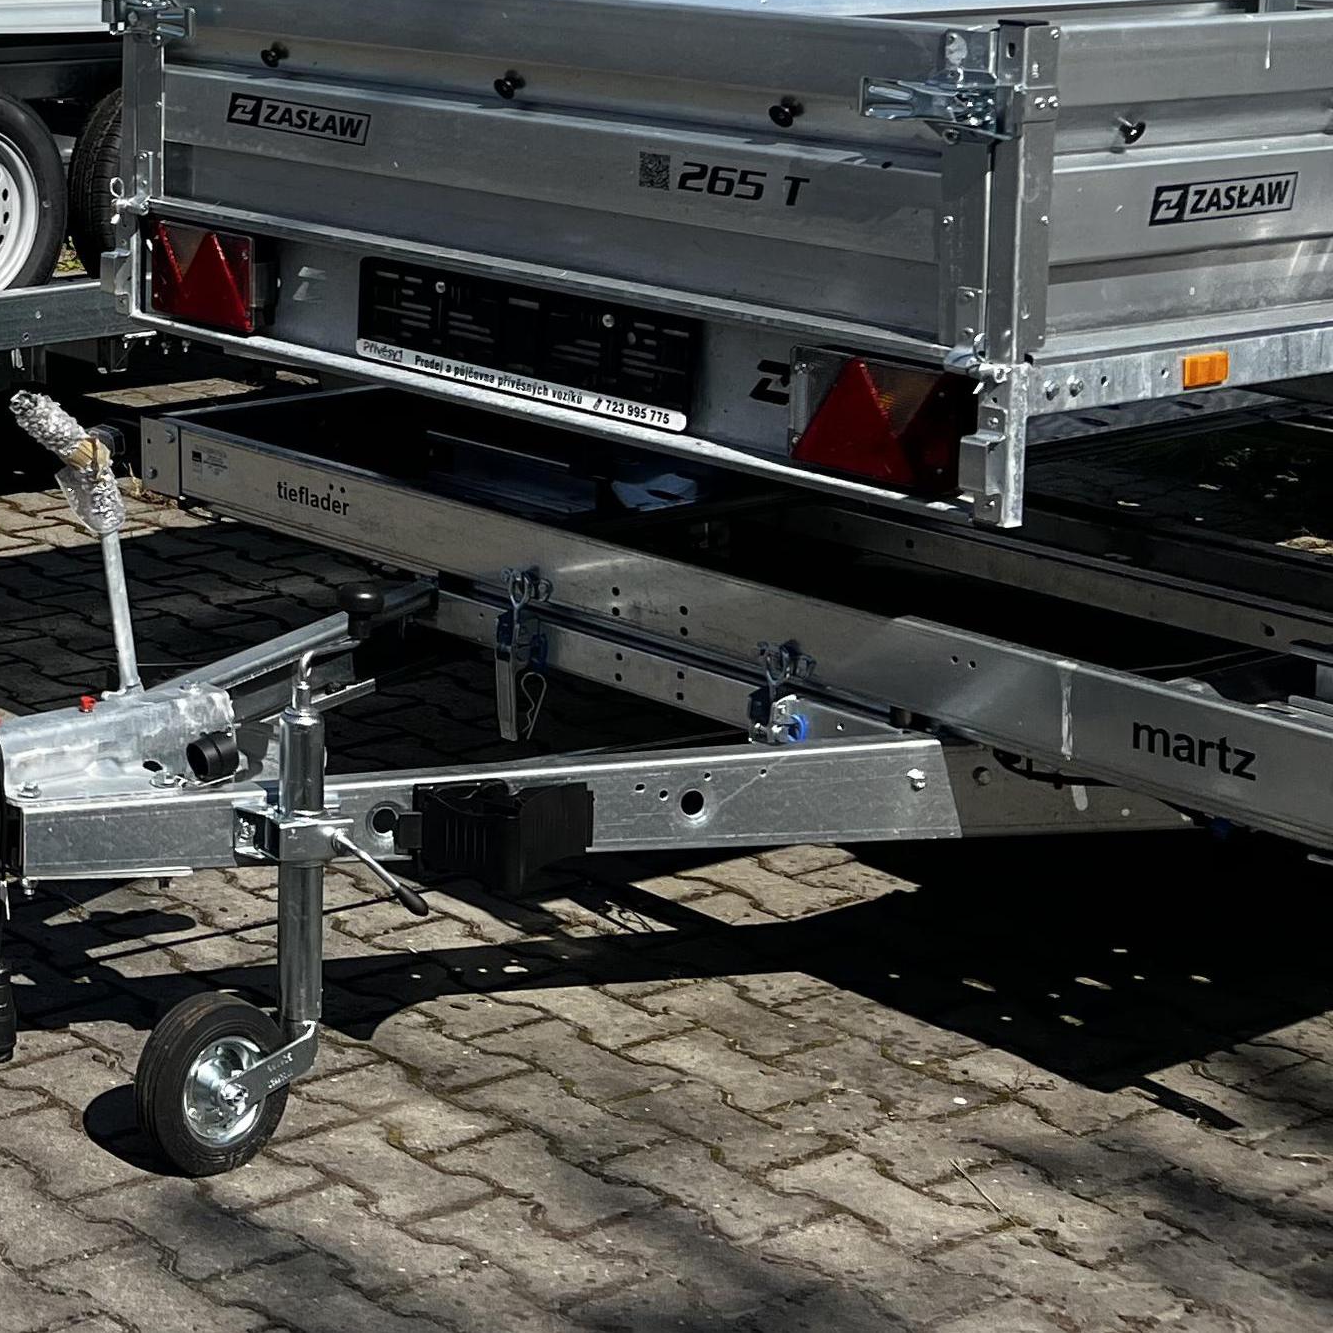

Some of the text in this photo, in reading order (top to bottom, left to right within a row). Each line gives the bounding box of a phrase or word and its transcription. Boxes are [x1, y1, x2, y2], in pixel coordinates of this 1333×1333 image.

[263, 104, 364, 139] ZASŁAW
[677, 161, 811, 206] 265 T
[1189, 179, 1290, 215] ZASŁAW
[605, 399, 625, 415] 723
[627, 404, 647, 420] 995
[649, 410, 670, 425] 775
[276, 480, 350, 516] tieflader
[1132, 720, 1257, 782] martz
